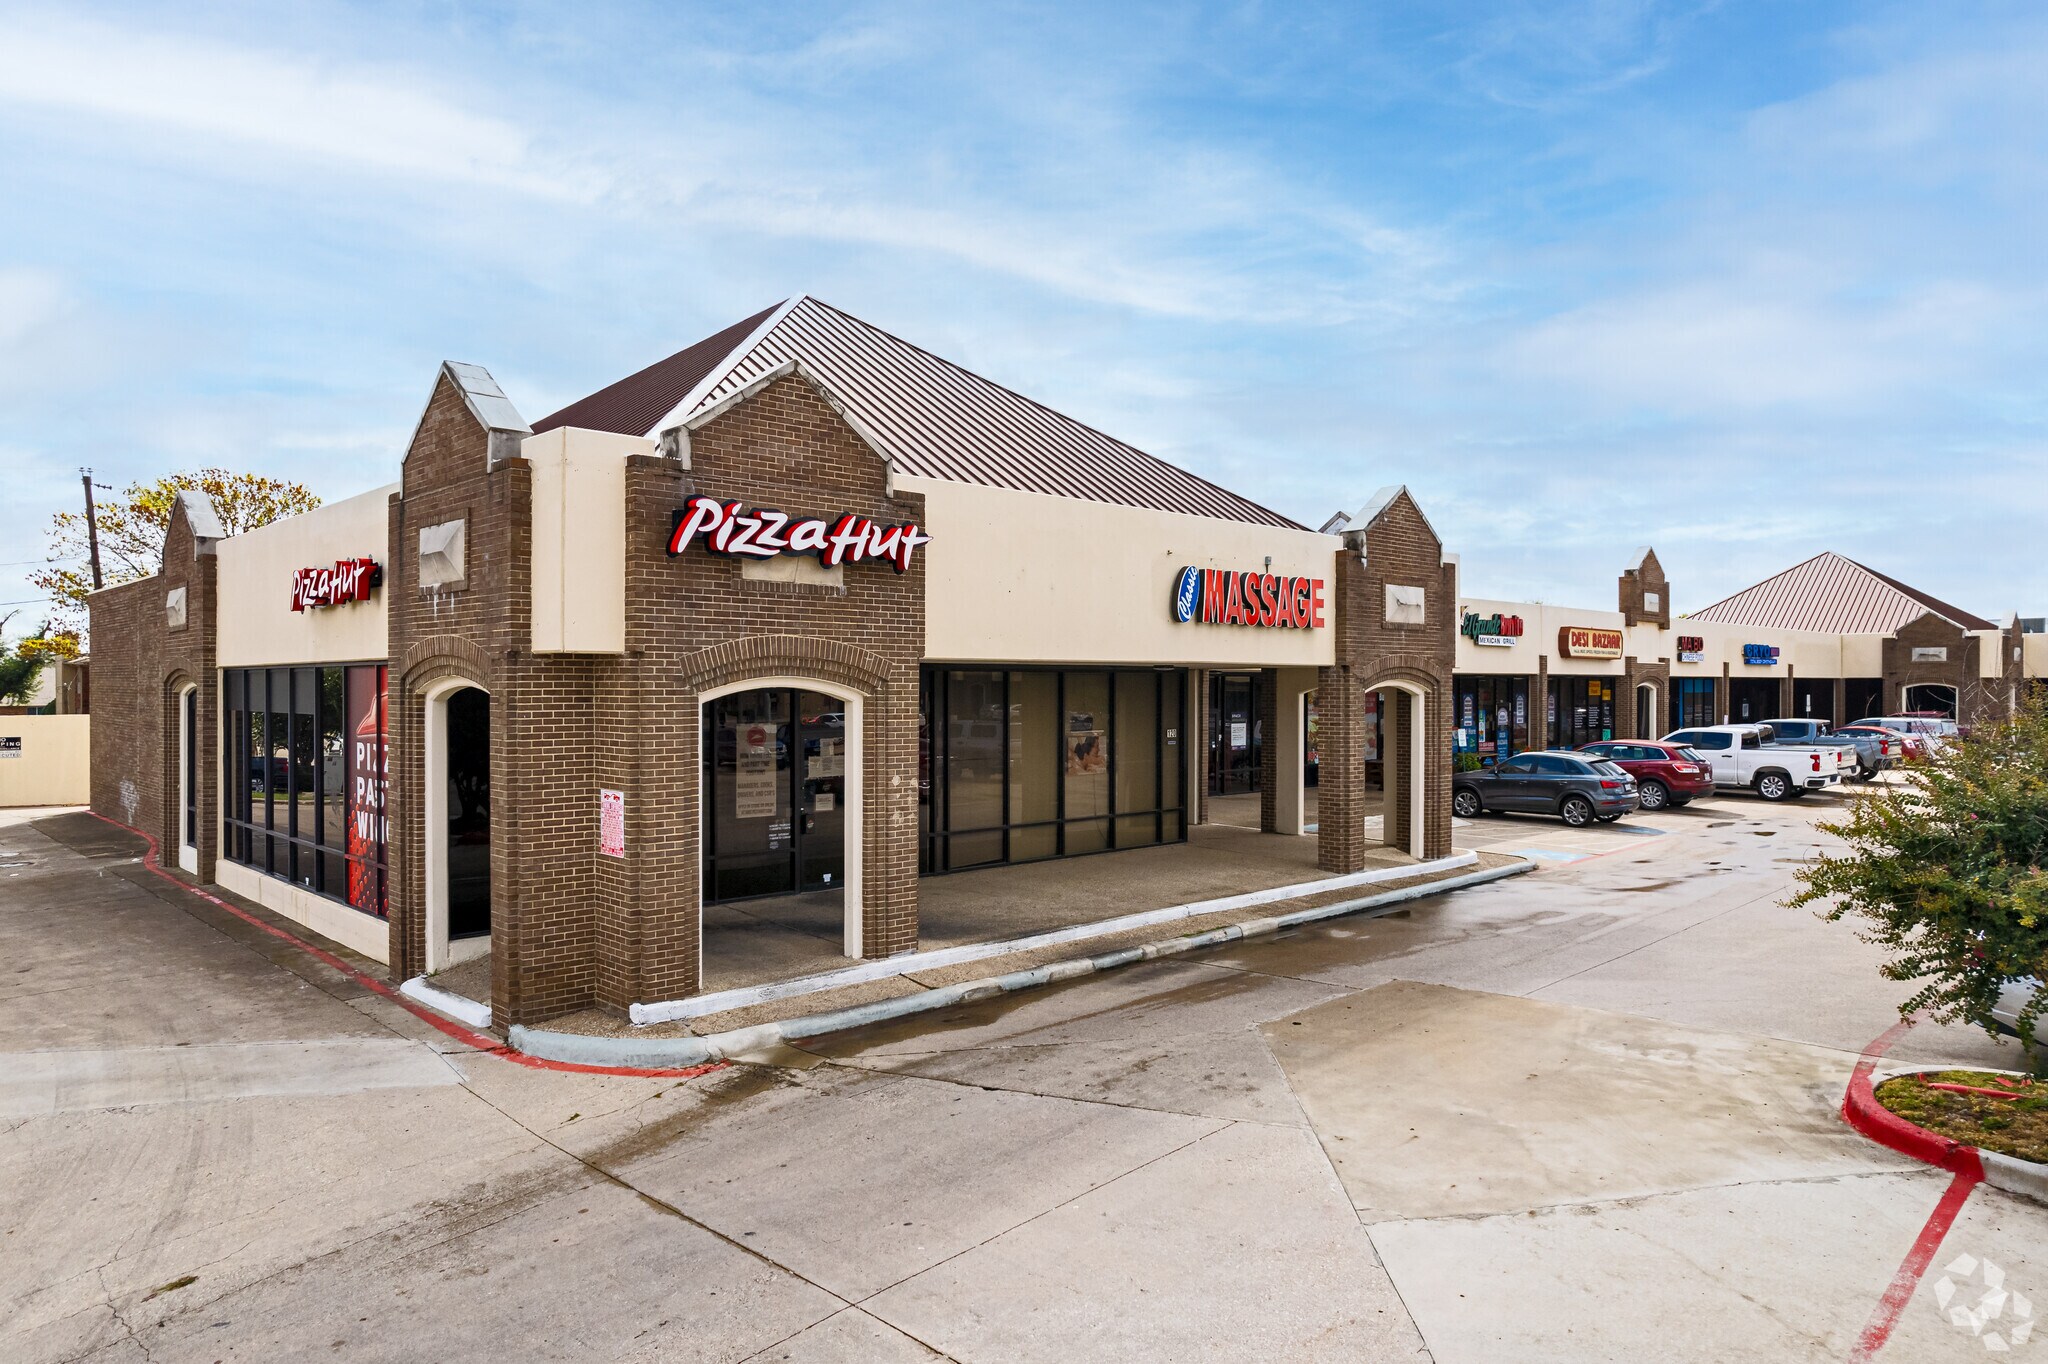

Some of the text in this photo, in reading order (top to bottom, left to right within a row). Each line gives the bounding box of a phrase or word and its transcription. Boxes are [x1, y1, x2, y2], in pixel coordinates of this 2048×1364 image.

[675, 498, 934, 571] Pizza Hut
[290, 558, 366, 612] Pizza Hut
[1178, 566, 1325, 629] Classic MASSAGE
[1479, 636, 1515, 645] MEXICAN GRILL
[1571, 631, 1621, 650] DESI BAZAAR
[1745, 644, 1771, 658] CRYO
